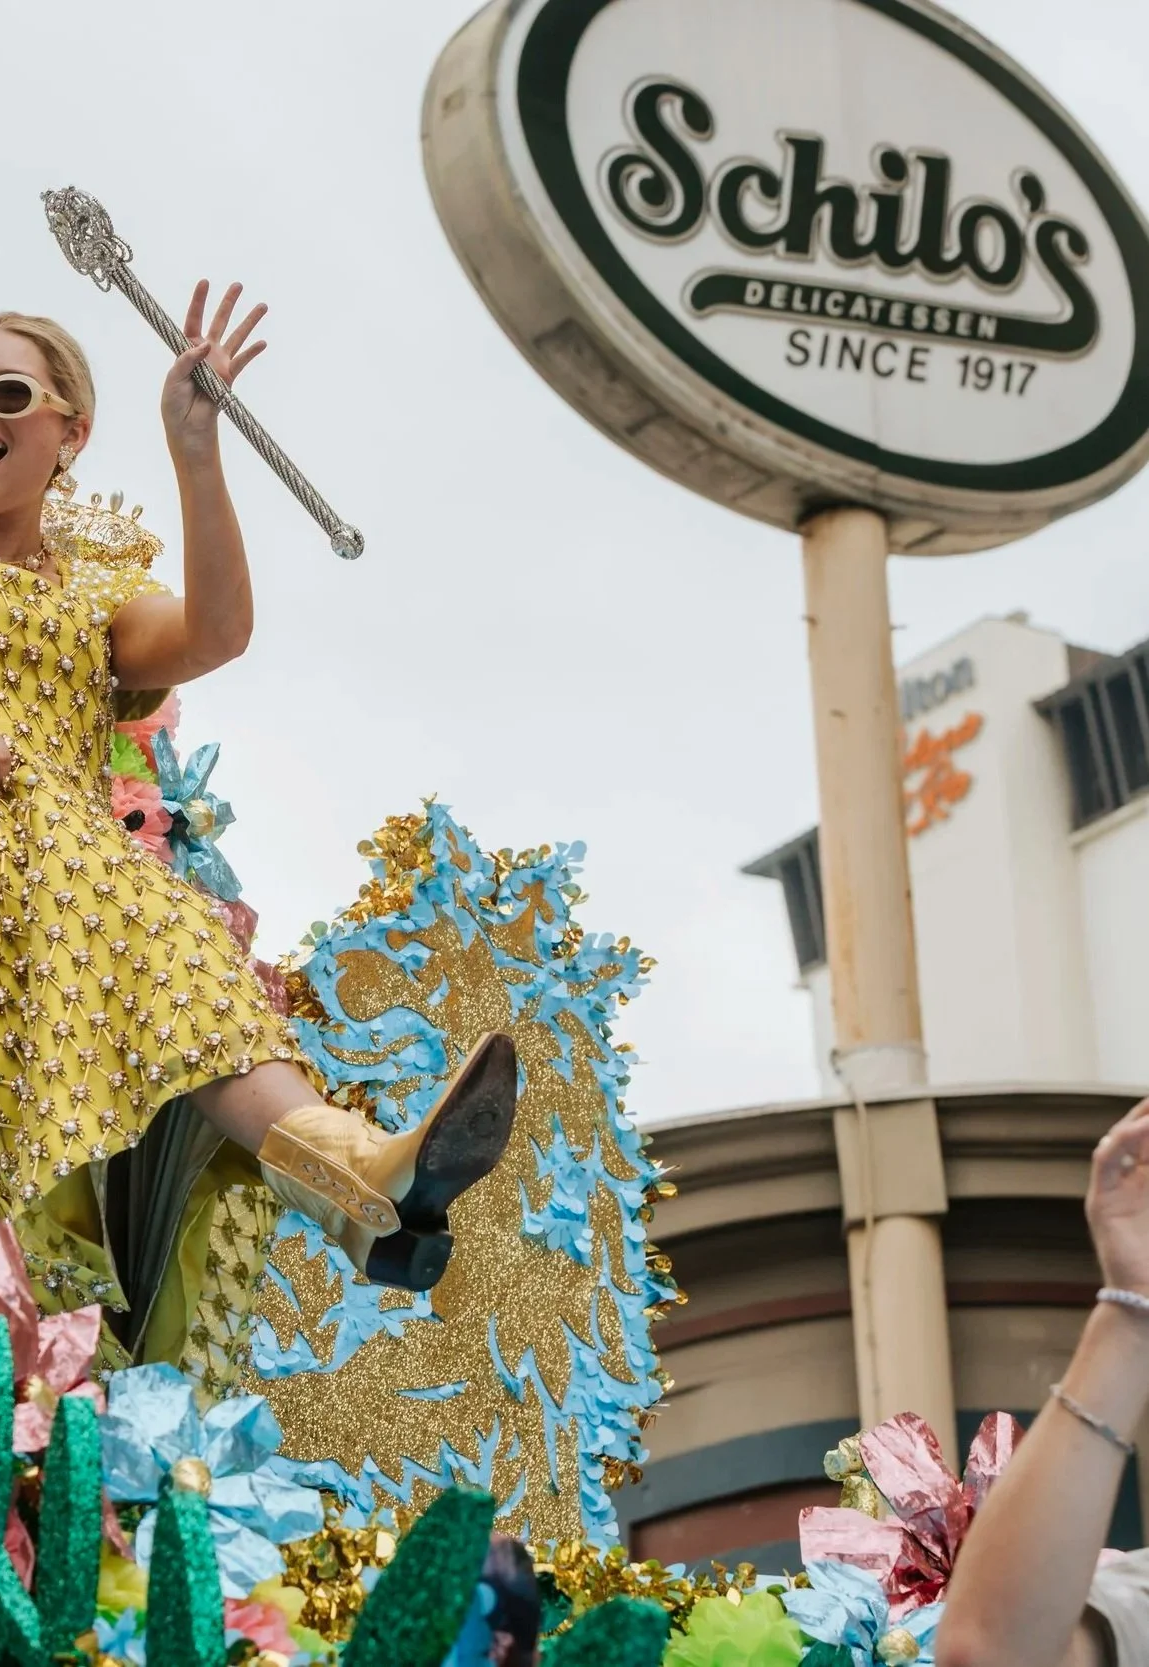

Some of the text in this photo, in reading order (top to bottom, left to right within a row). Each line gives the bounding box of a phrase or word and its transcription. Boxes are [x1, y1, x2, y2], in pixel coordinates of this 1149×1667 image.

[598, 75, 1098, 335] Schilo's
[744, 280, 998, 340] DELICATESSEN
[785, 329, 1038, 396] SINCE 1917
